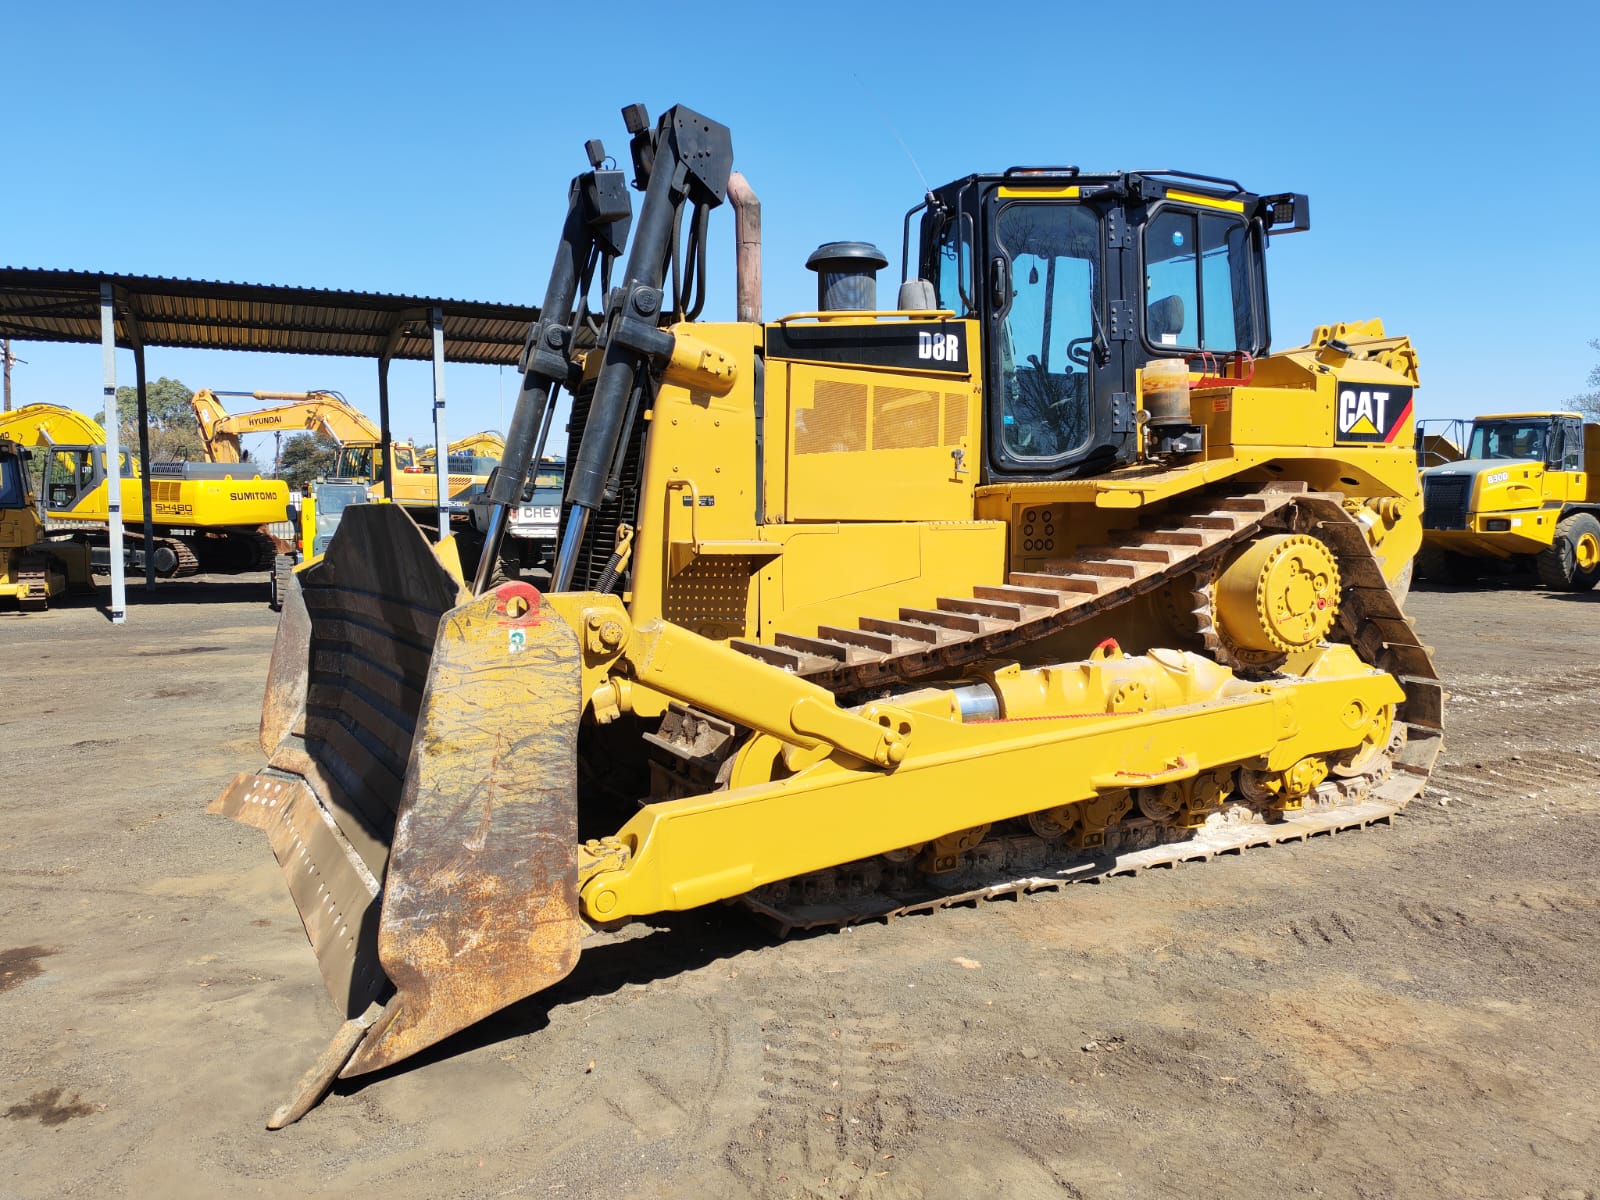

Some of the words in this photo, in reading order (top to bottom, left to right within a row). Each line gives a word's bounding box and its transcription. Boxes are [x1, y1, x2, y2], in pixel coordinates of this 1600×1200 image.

[918, 331, 959, 362] D8R
[1339, 390, 1390, 434] CAT
[248, 415, 282, 426] HYUNDAI
[230, 491, 278, 501] SUMITOMO
[155, 503, 193, 512] SH480
